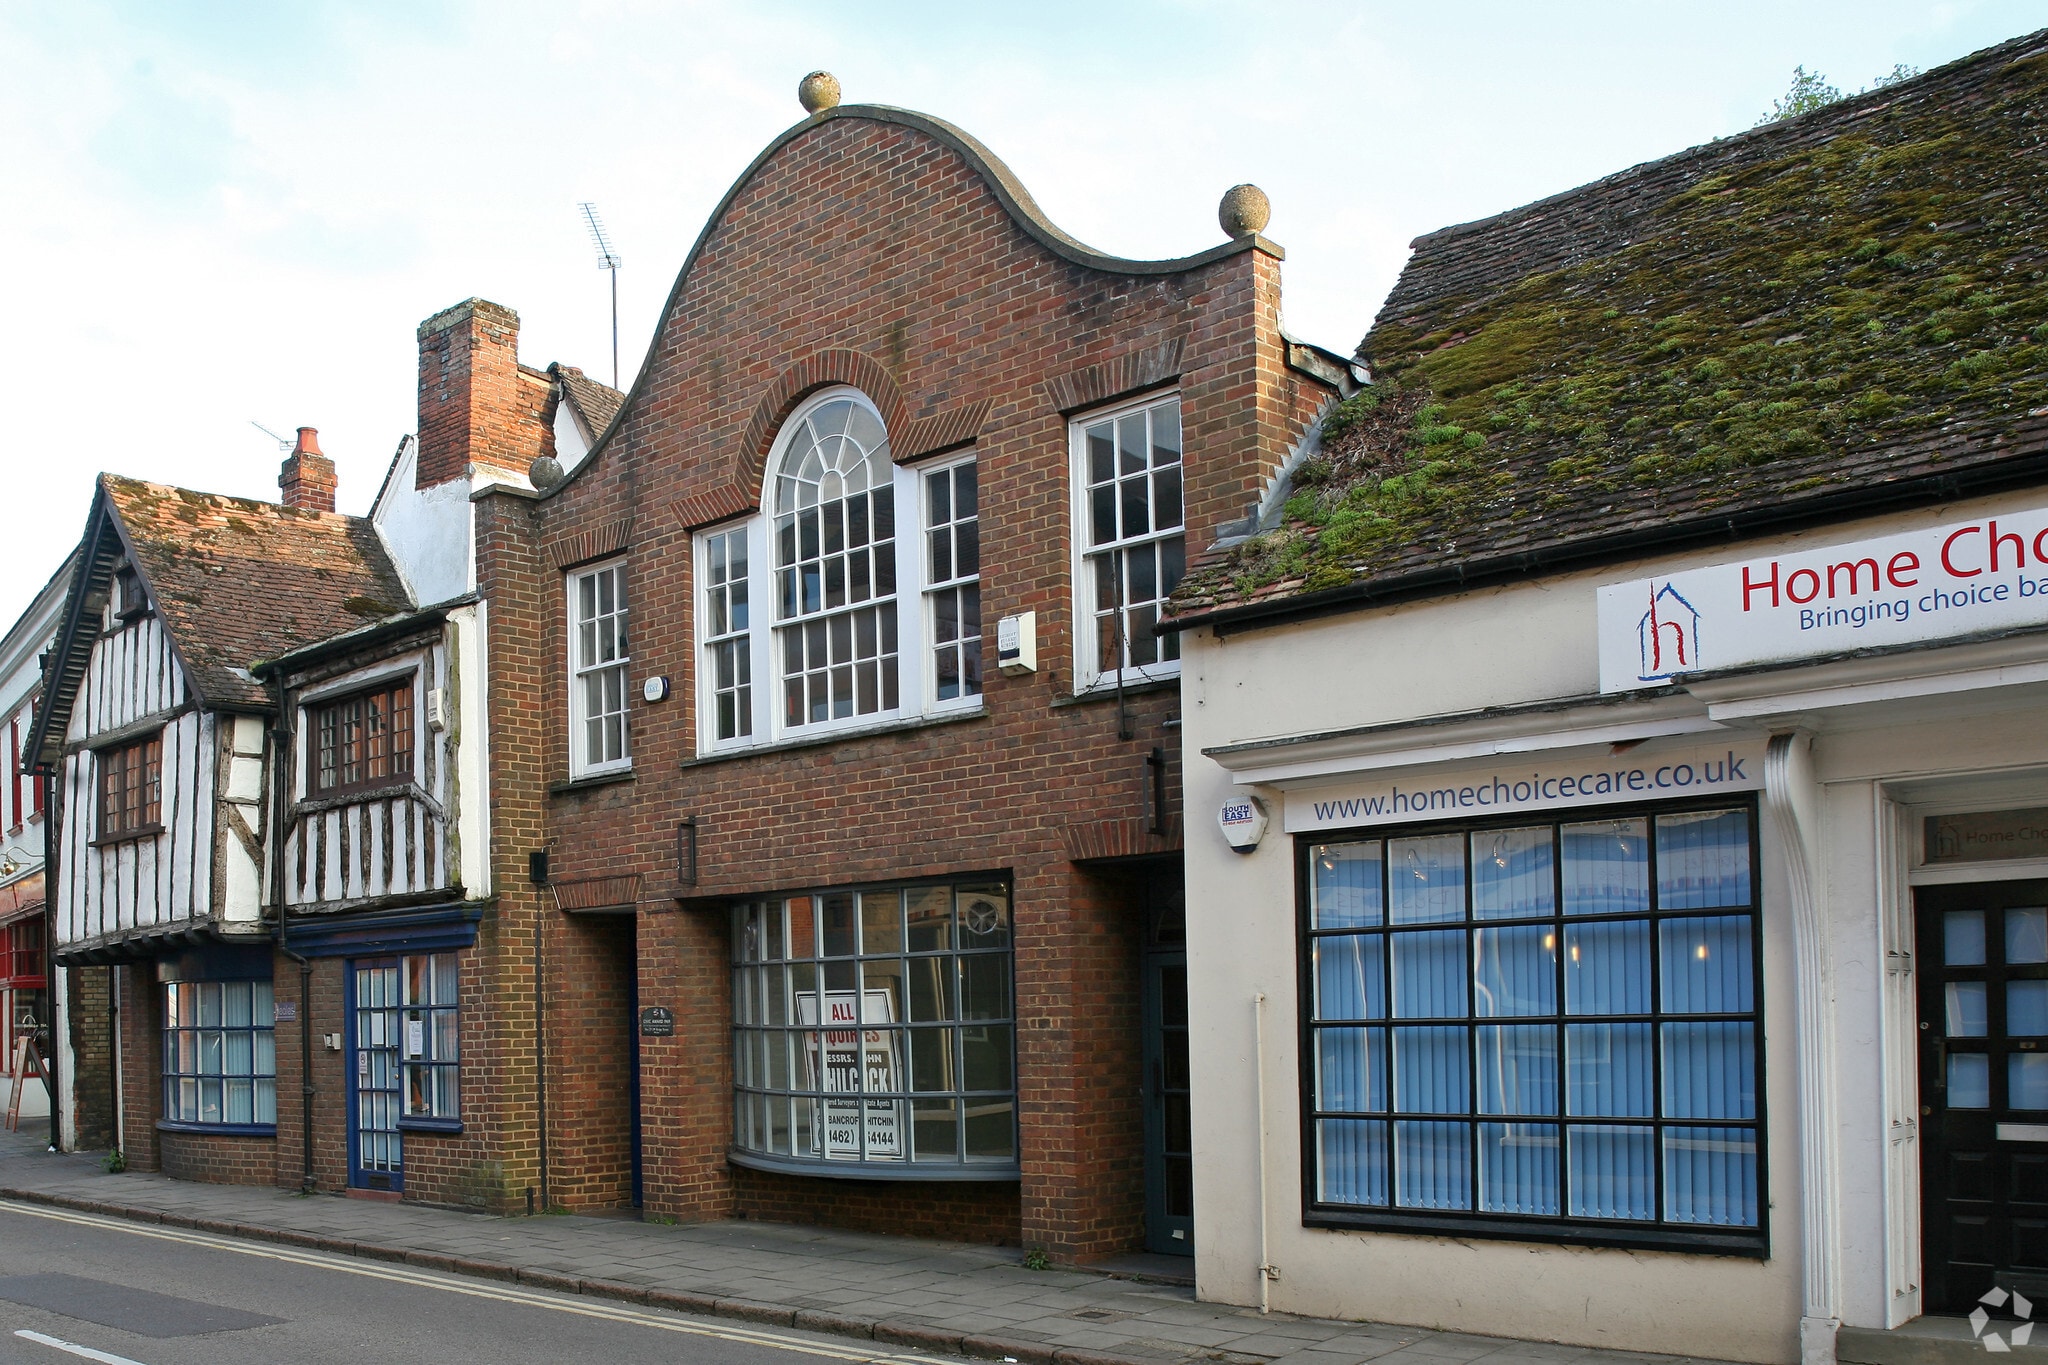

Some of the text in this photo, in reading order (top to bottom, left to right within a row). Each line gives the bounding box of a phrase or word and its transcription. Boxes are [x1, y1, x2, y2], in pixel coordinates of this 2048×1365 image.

[1742, 551, 1920, 611] Home
[1799, 599, 1910, 631] Bringing
[1918, 584, 2009, 613] choice
[1314, 750, 1747, 820] www.homechoicecare.co.uk
[1224, 810, 1249, 821] EAST
[1966, 831, 2014, 844] Home
[832, 1003, 855, 1021] ALL
[827, 1054, 855, 1063] ESSRS.
[828, 1115, 859, 1125] BANCROF
